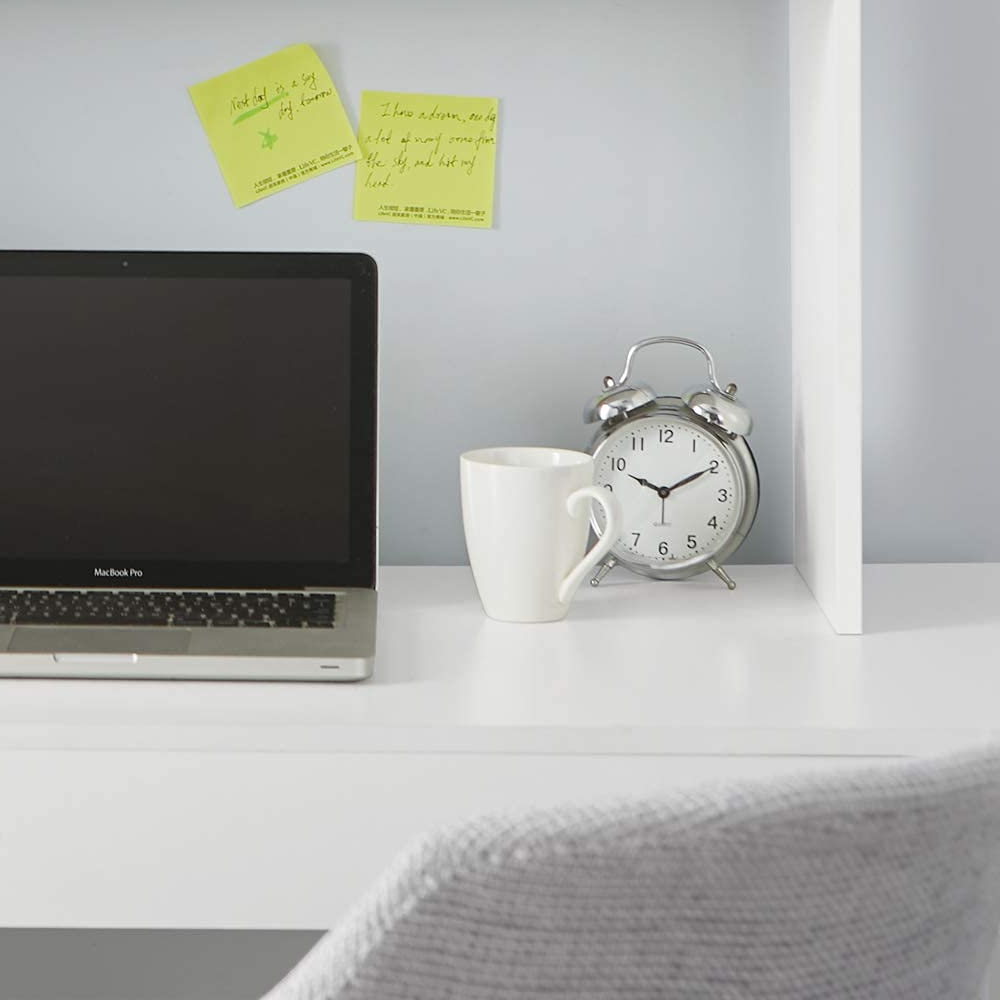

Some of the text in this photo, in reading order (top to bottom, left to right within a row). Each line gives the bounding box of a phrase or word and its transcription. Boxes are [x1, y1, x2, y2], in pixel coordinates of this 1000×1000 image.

[659, 429, 674, 443] 12
[632, 437, 644, 451] 11
[692, 439, 696, 453] 1
[611, 457, 627, 471] 10
[709, 460, 719, 474] 2
[717, 489, 728, 502] 3
[707, 515, 718, 529] 4
[632, 532, 641, 546] 7
[687, 535, 697, 549] 5
[658, 541, 668, 555] 6
[94, 568, 143, 577] MacBook Pro
